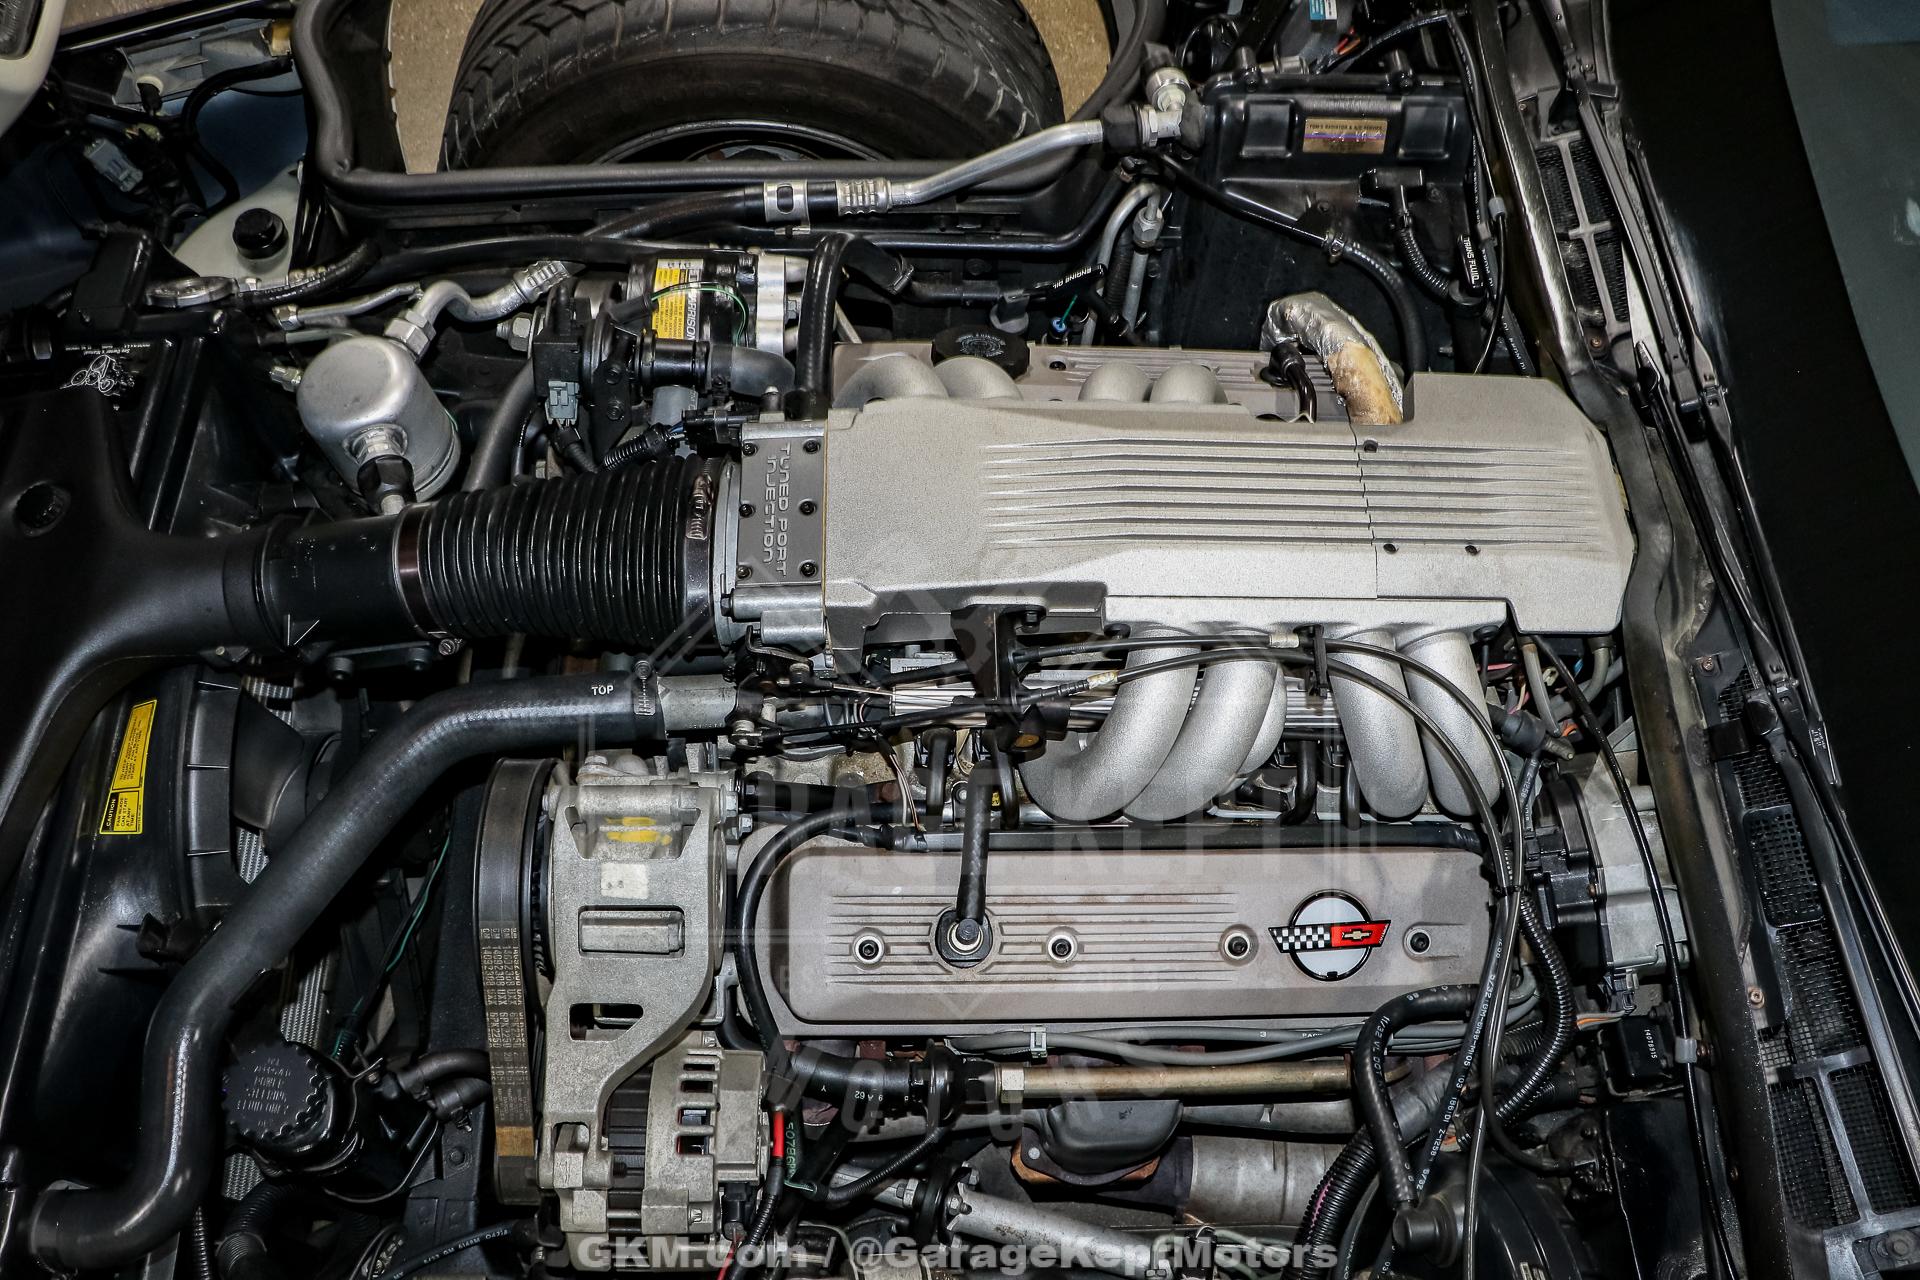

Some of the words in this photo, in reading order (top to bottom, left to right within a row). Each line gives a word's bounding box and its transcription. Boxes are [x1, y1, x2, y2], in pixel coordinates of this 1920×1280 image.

[1464, 237, 1474, 259] TRANS
[779, 442, 791, 511] TUNED
[763, 455, 777, 562] INJECTION
[776, 518, 789, 576] PORT
[591, 684, 614, 696] TOP
[106, 798, 116, 827] CAUTION
